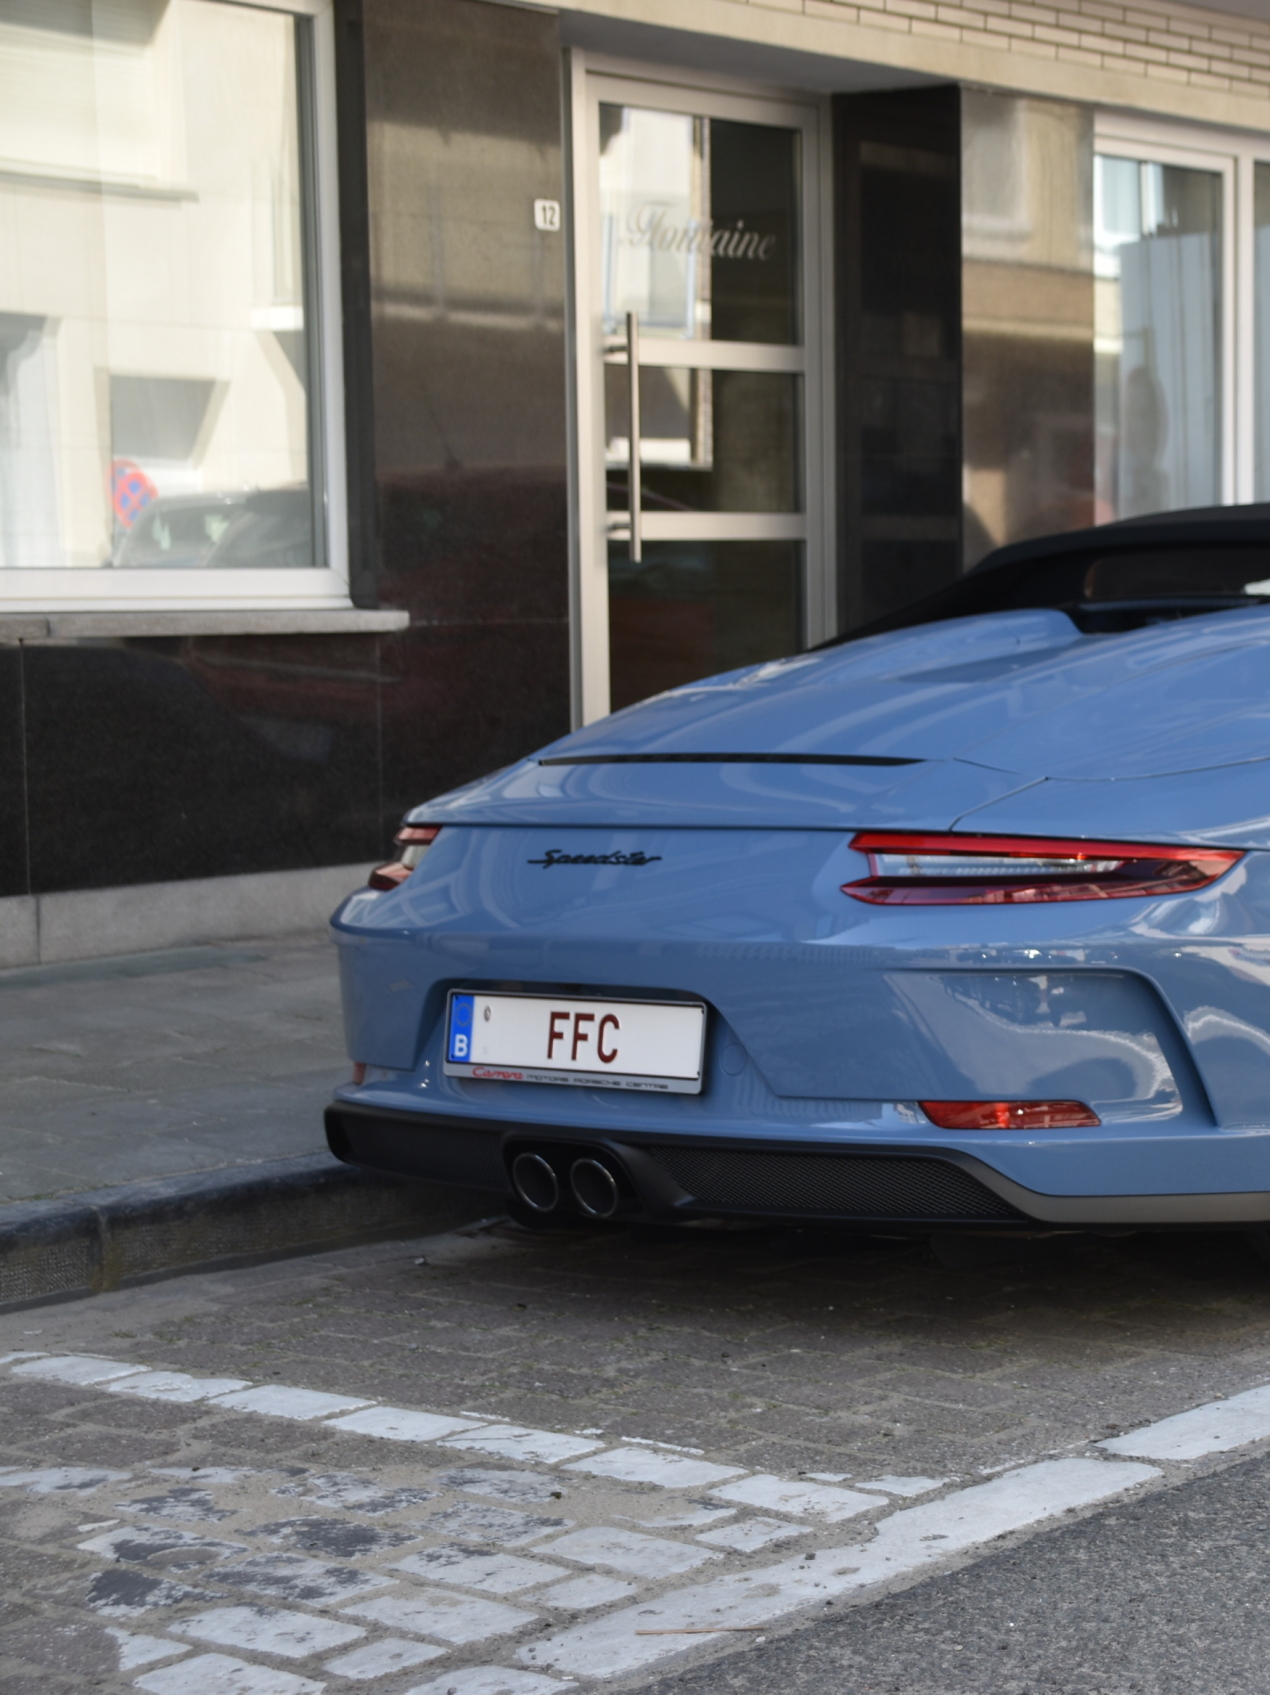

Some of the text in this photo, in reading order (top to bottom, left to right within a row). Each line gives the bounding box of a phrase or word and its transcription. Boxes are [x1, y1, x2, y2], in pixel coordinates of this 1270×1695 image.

[542, 205, 556, 226] 12
[527, 849, 663, 869] Speedster
[454, 1034, 468, 1057] B
[547, 1011, 621, 1064] FFC
[472, 1065, 524, 1080] Carrera
